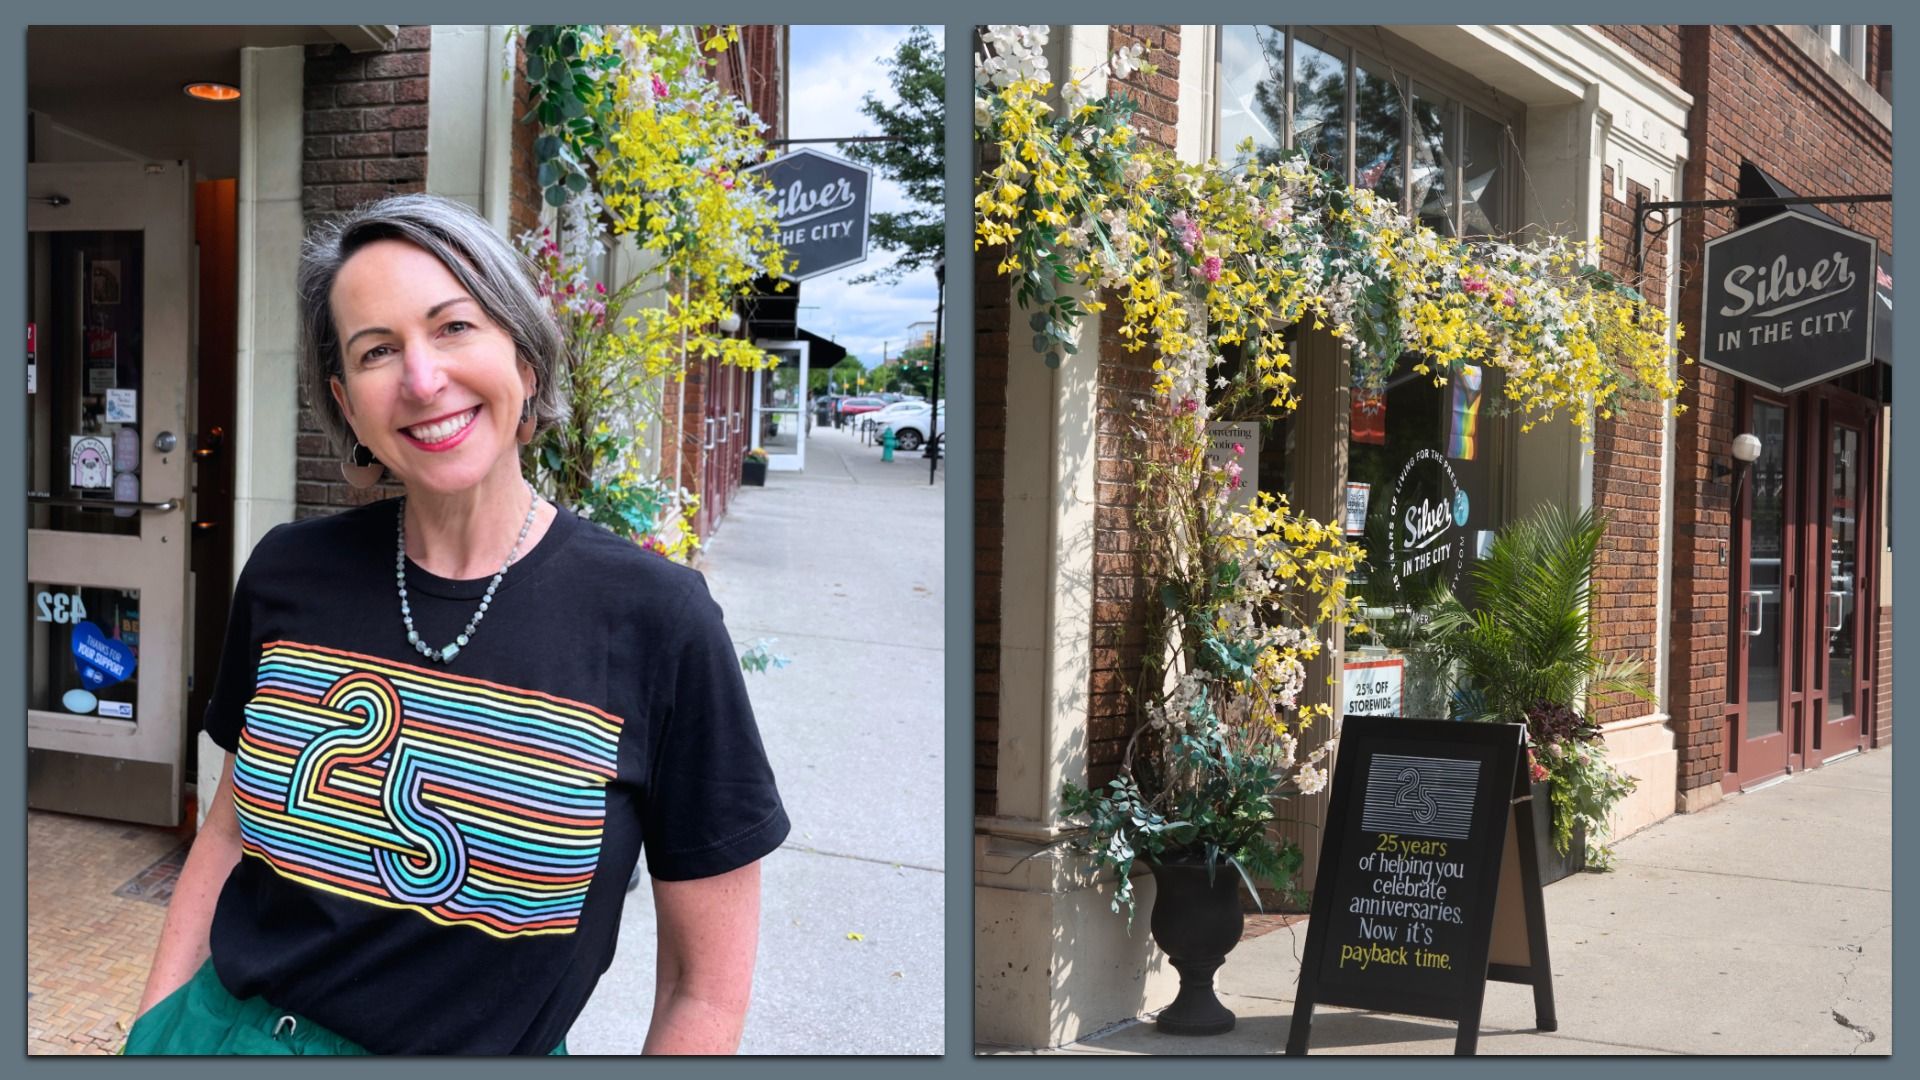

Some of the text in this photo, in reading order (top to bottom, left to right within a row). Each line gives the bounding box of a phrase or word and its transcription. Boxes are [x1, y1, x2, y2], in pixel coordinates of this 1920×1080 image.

[811, 220, 853, 241] CITY
[1720, 251, 1856, 318] Silver
[1718, 309, 1855, 352] IN THE CITY
[1207, 427, 1253, 440] onverting
[1415, 448, 1429, 461] FOR
[1430, 449, 1443, 464] THE
[1395, 456, 1415, 494] LIVING
[1391, 495, 1398, 516] OF
[1403, 497, 1452, 549] Silver
[1388, 521, 1396, 571] YEARS
[1403, 542, 1452, 578] IN THE CITY
[78, 641, 97, 660] YOUR
[95, 652, 125, 676] SUPPORT
[86, 634, 110, 656] THANKS
[109, 647, 122, 662] FOR
[1356, 681, 1389, 696] 25% OFF
[1349, 697, 1392, 713] STOREWIDE
[287, 671, 467, 905] 25
[1394, 767, 1438, 825] 25
[1376, 833, 1448, 861] 25 years
[1358, 852, 1465, 887] of helping you
[1373, 875, 1448, 900] celebrate
[1349, 896, 1464, 925] anniversaries.
[1358, 917, 1433, 946] Now it's
[1339, 942, 1452, 971] payback time.
